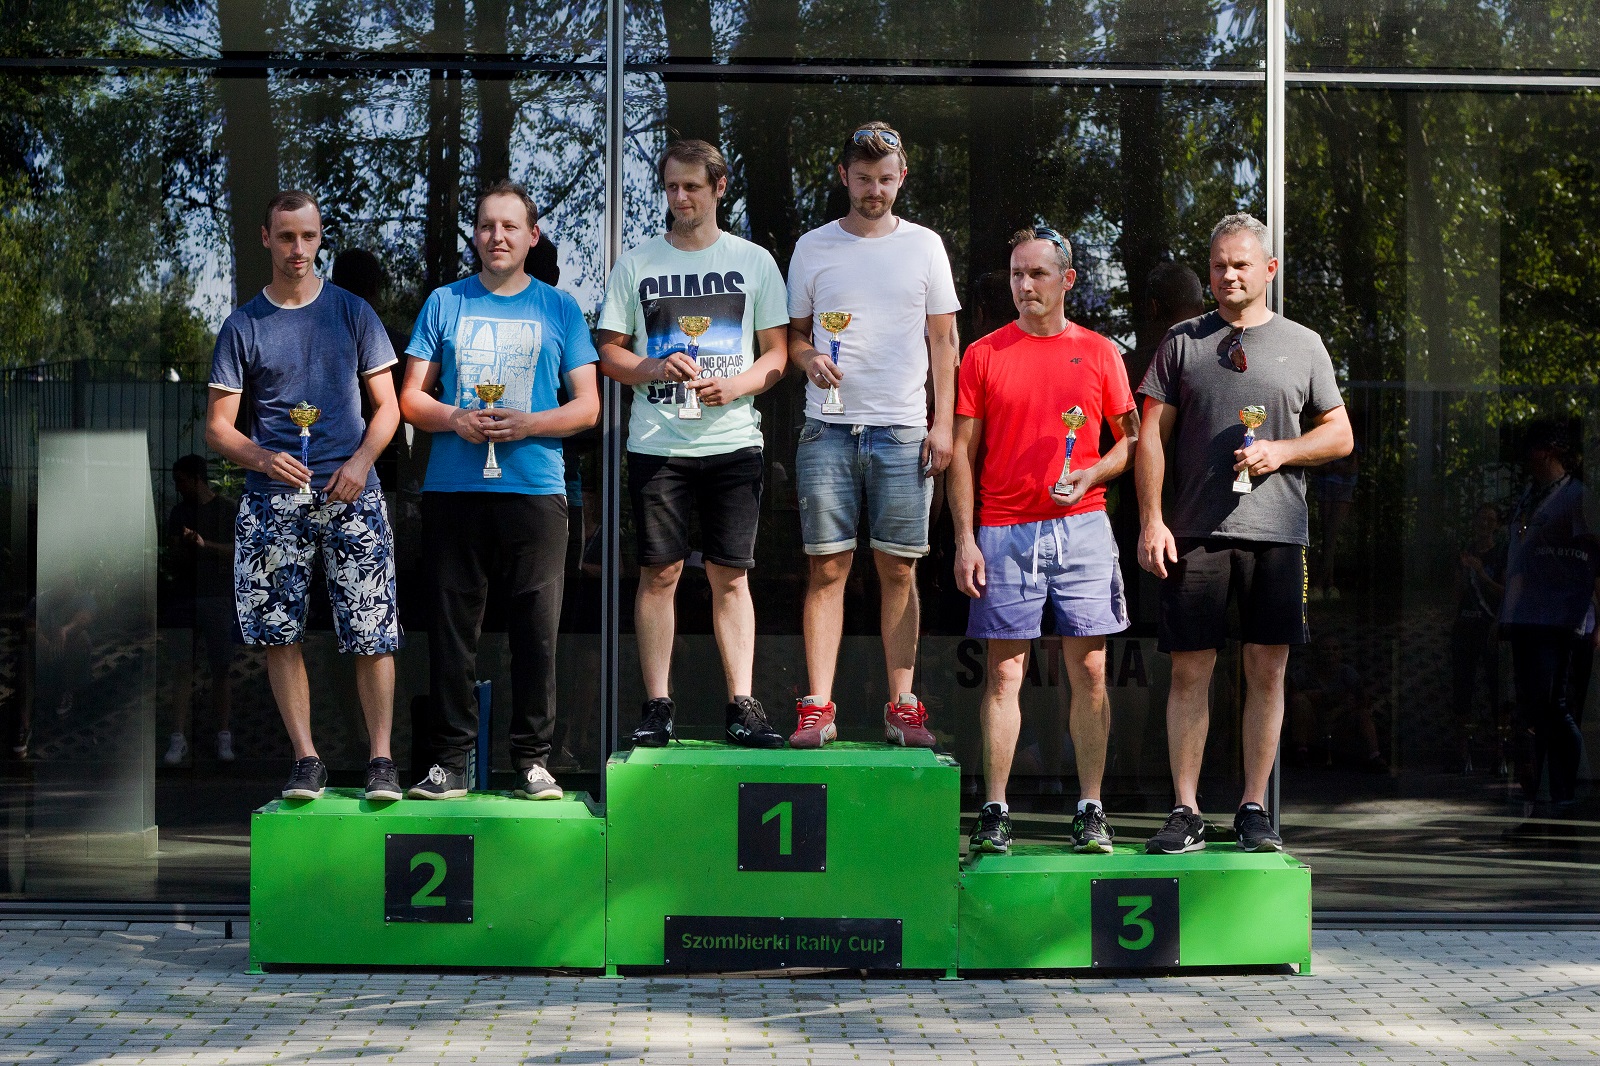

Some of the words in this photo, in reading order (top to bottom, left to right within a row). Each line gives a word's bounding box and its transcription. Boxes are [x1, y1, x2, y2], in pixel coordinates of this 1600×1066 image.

[639, 271, 745, 300] CHAOS
[716, 354, 744, 368] CHAOS
[761, 801, 793, 855] 1
[409, 851, 448, 907] 2
[681, 932, 790, 950] Szombierki
[796, 935, 842, 953] Rally
[849, 936, 885, 954] Cup
[1117, 895, 1155, 951] 3
